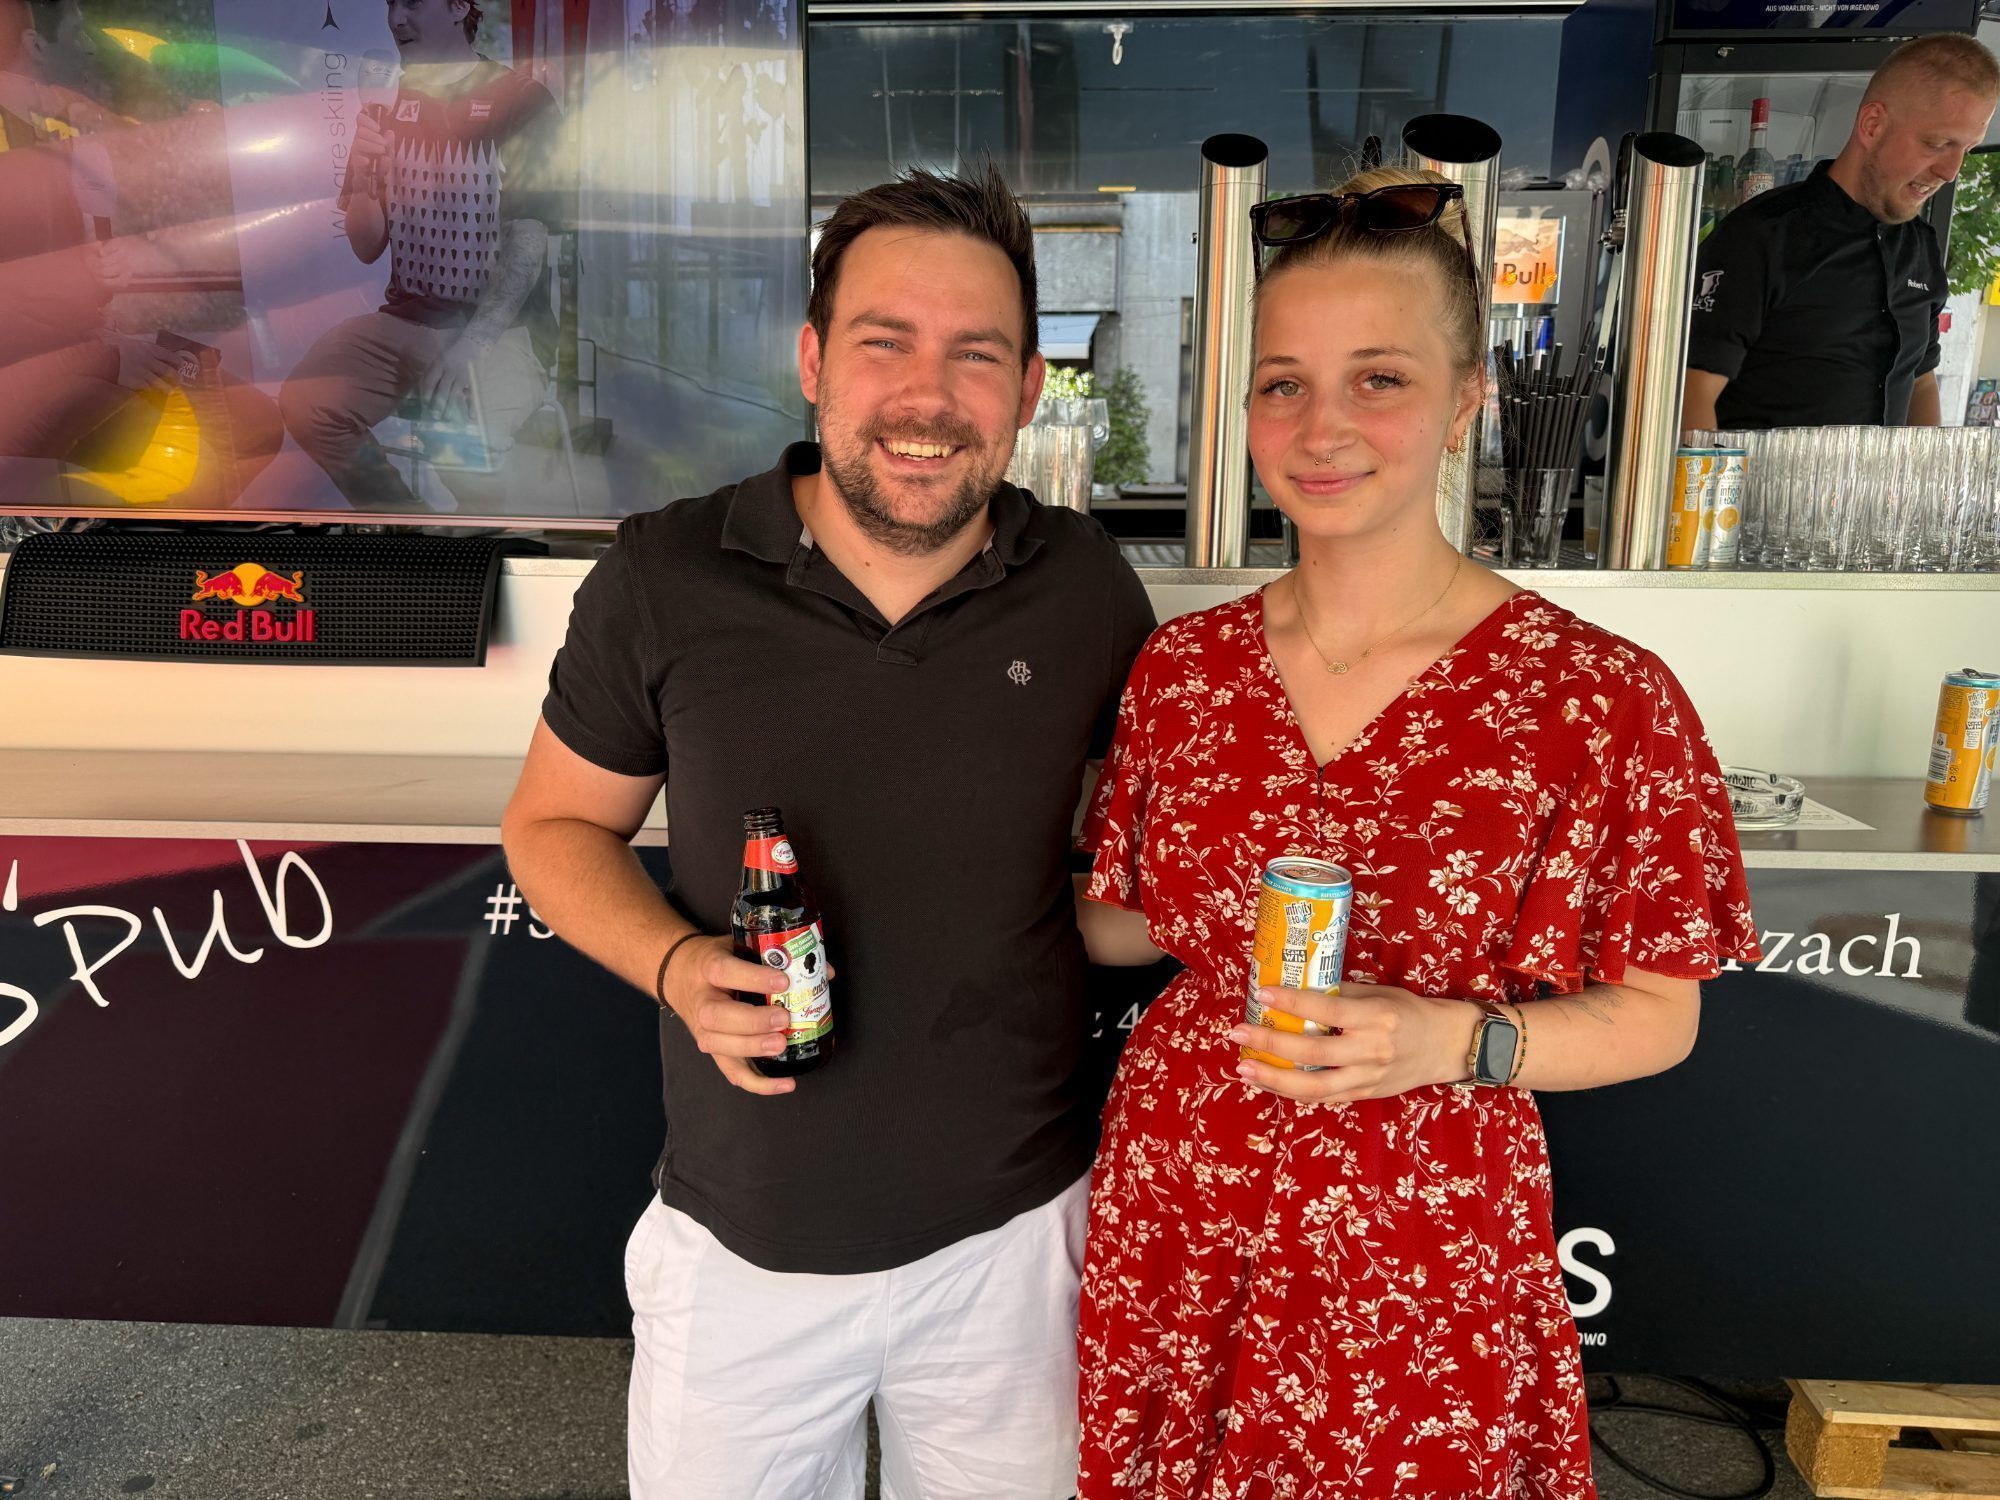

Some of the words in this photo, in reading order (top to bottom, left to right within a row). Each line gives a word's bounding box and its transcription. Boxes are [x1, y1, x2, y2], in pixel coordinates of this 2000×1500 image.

[320, 52, 348, 137] skiing
[1502, 262, 1547, 285] Bull
[180, 609, 245, 641] Red
[251, 609, 317, 642] Bull
[1284, 901, 1313, 917] infinity
[1284, 954, 1307, 963] WIN
